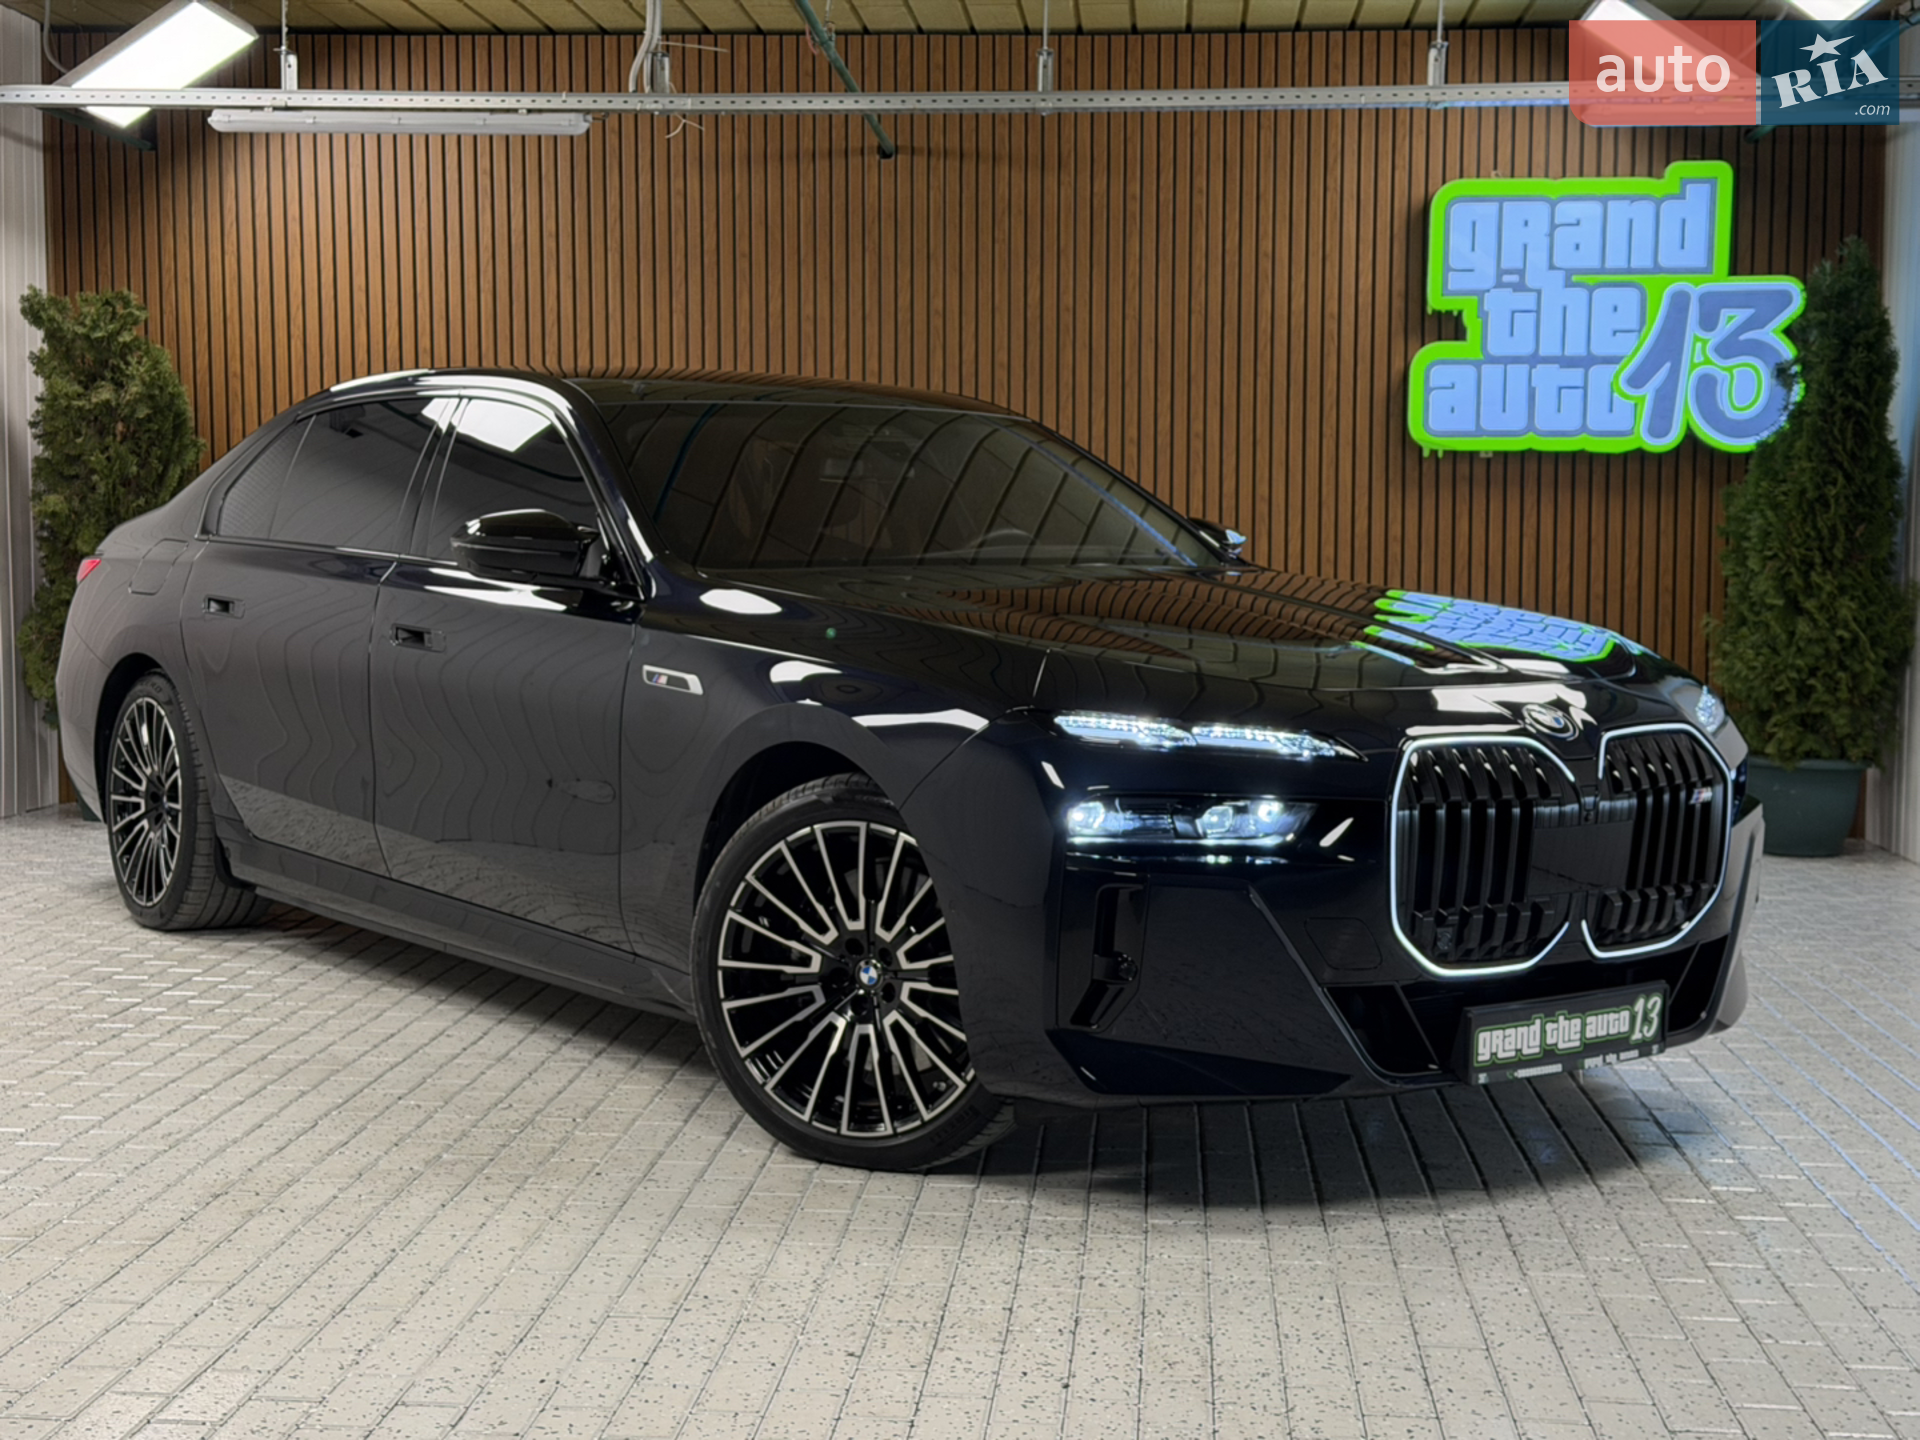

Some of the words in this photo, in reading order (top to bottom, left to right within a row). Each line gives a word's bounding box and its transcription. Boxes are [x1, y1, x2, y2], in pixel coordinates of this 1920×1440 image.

[1484, 270, 1642, 357] the
[1618, 281, 1802, 446] 13
[1545, 1015, 1582, 1050] the
[1585, 1009, 1631, 1040] auto
[1631, 995, 1662, 1041] 13
